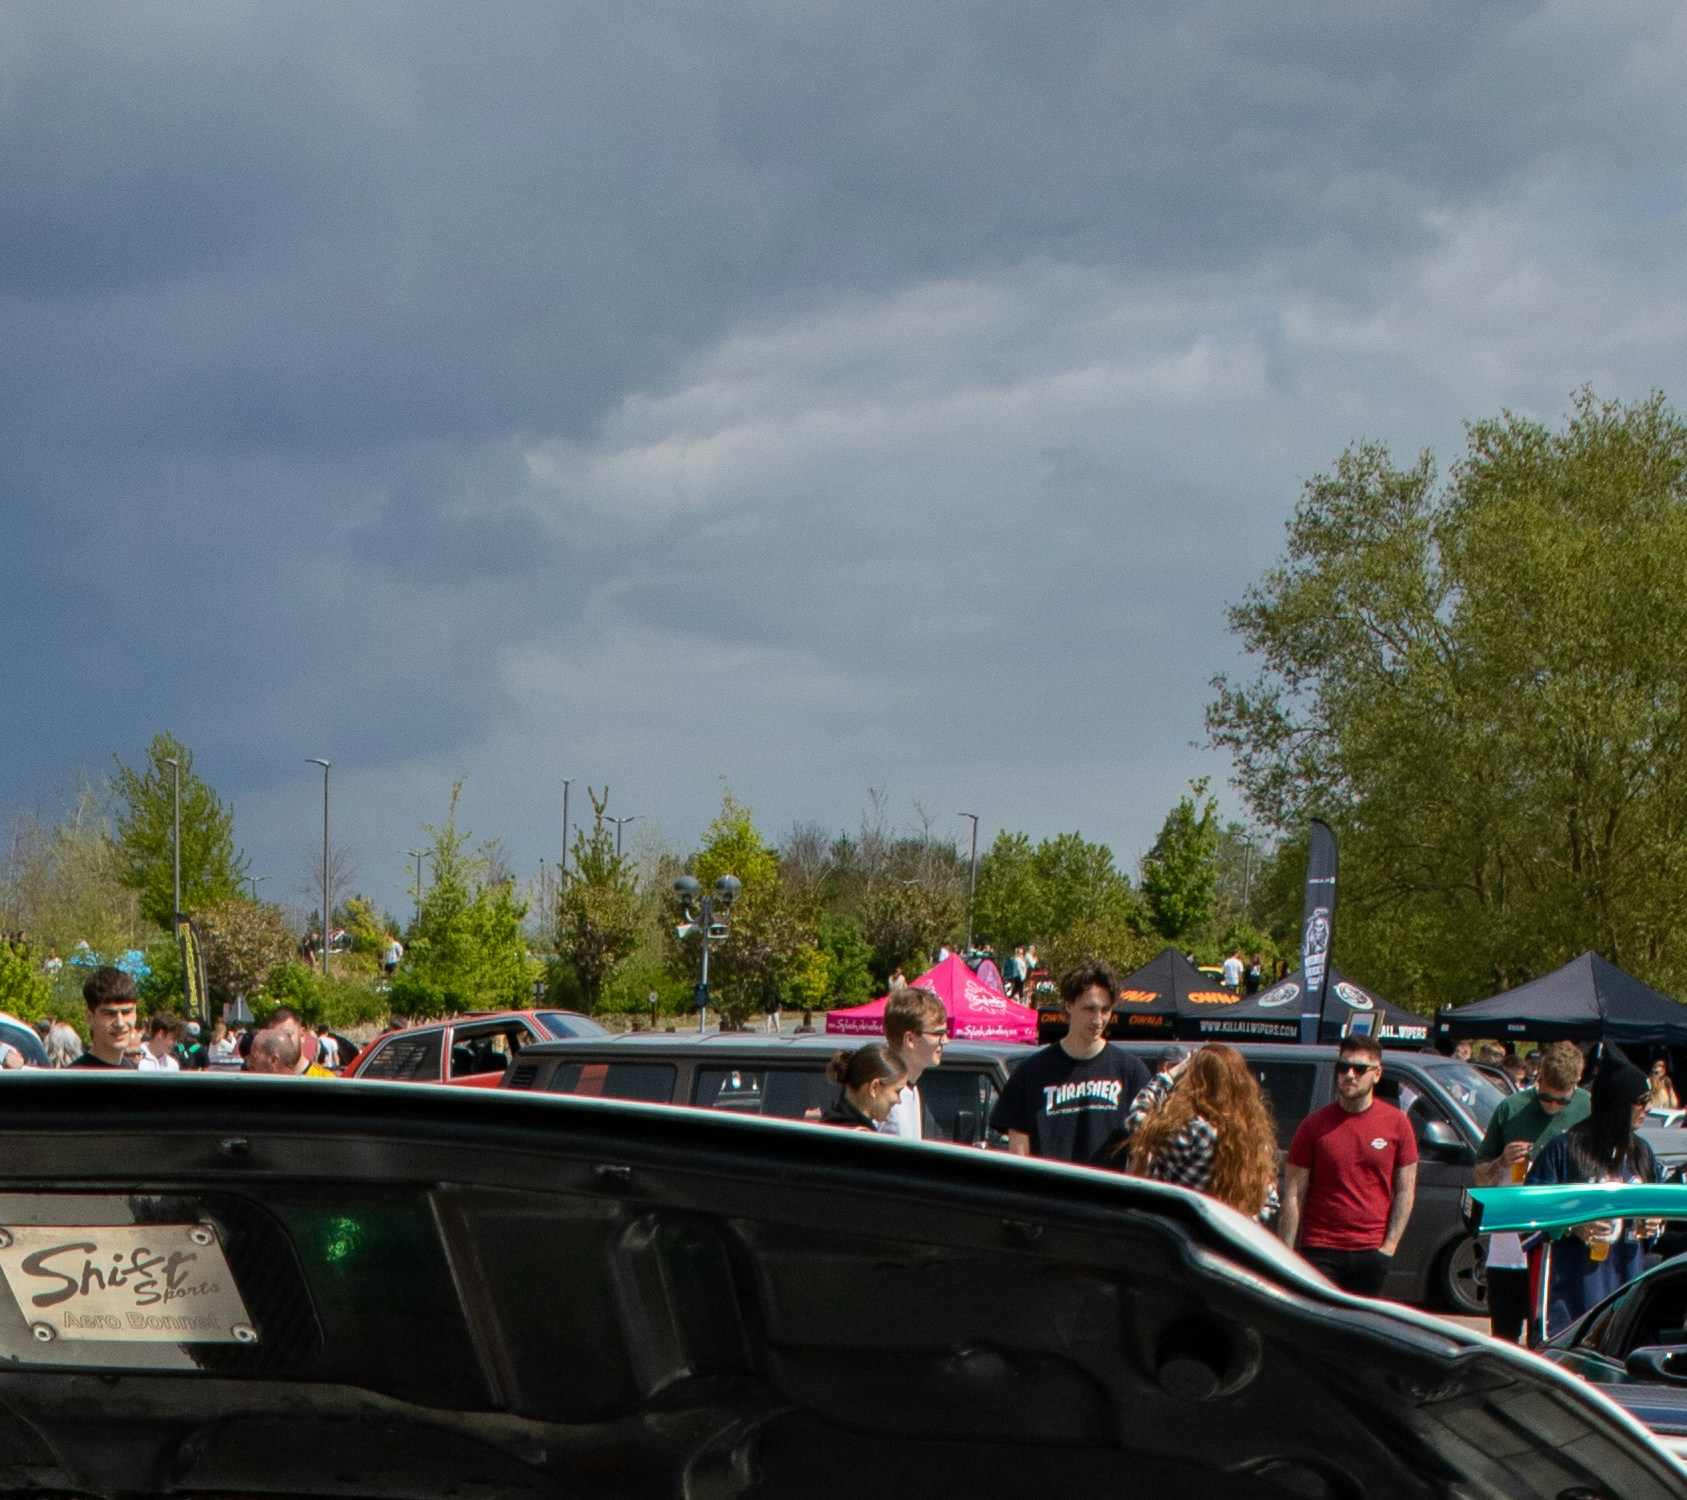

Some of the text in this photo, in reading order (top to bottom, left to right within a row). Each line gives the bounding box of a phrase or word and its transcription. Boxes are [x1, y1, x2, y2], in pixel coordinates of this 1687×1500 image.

[1200, 1020, 1298, 1038] WWW.KILLALLWIPERS.COM
[1044, 1080, 1122, 1111] THRASHER
[21, 1242, 197, 1308] Shift
[133, 1279, 222, 1306] Sports
[63, 1310, 218, 1331] Aero Bonnet
